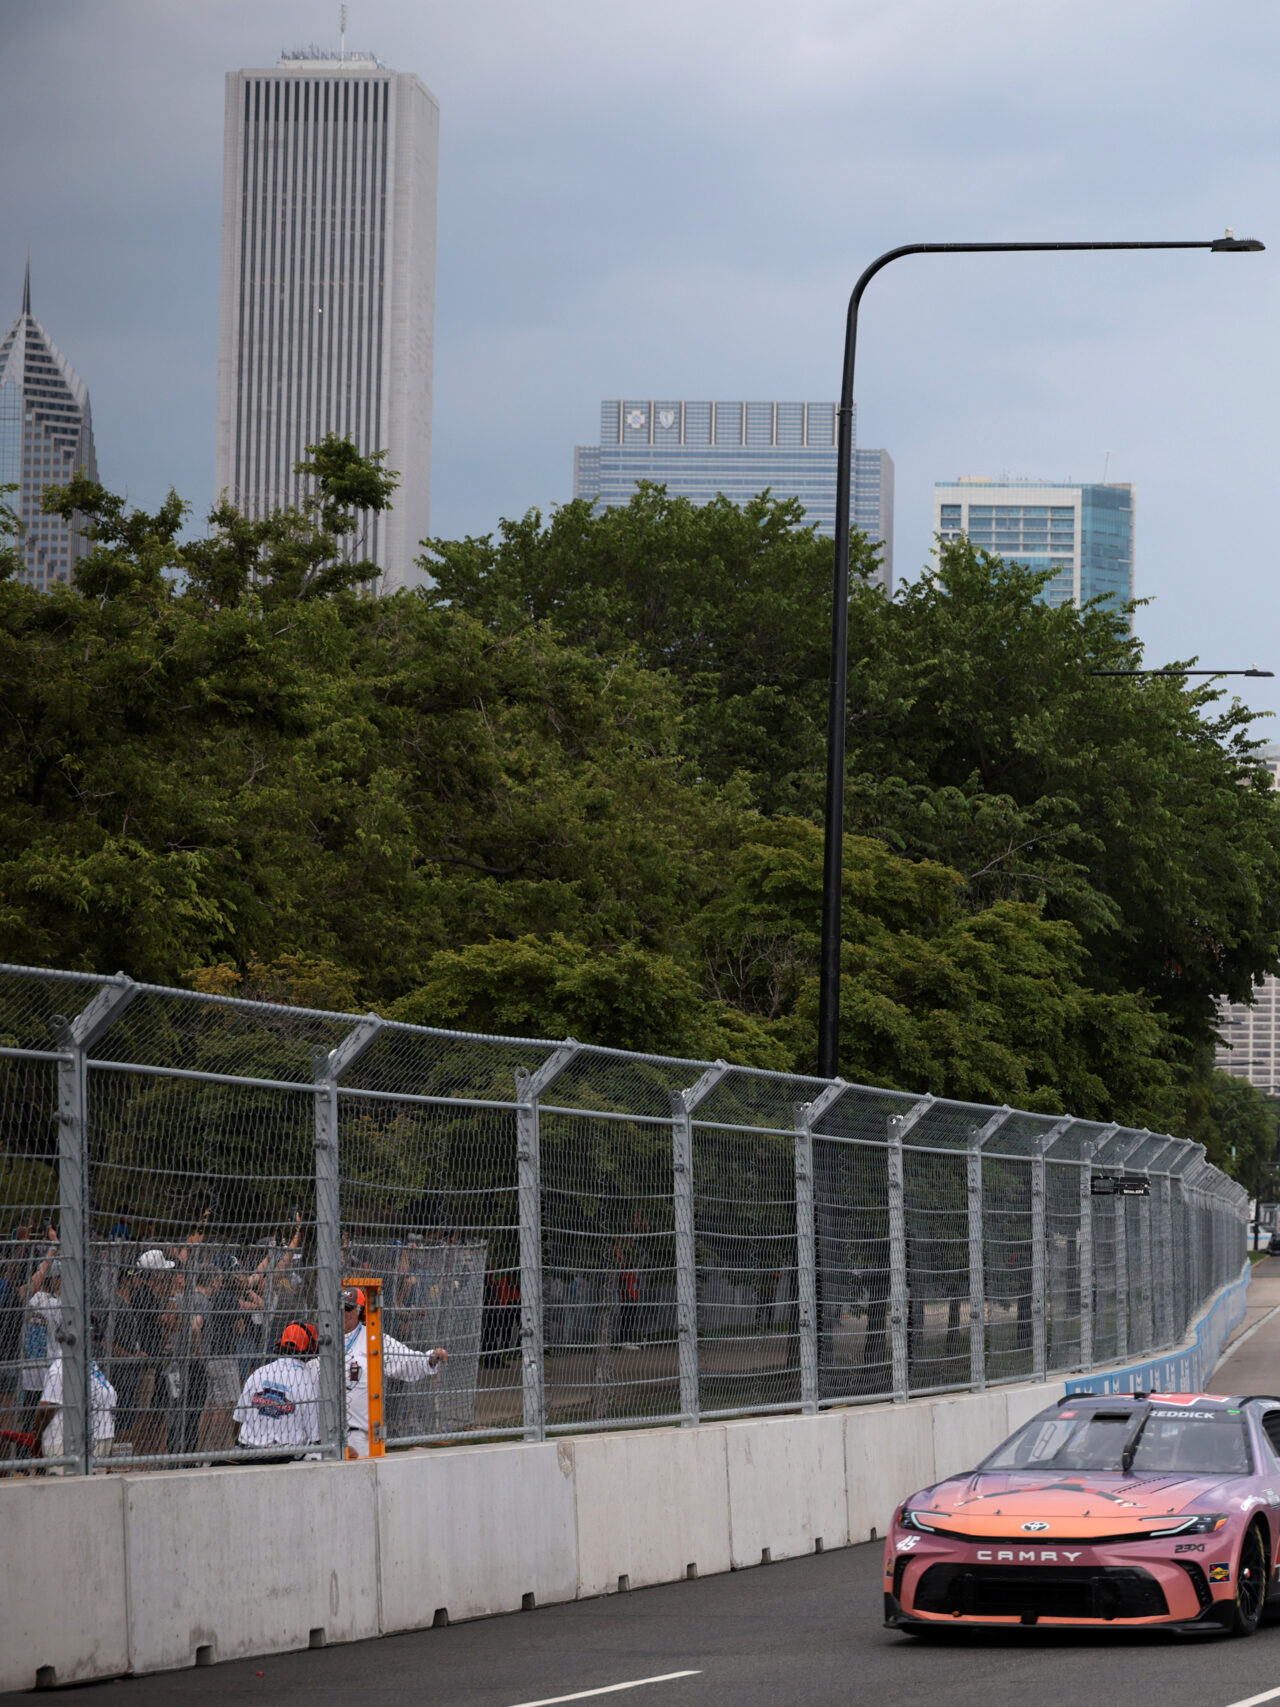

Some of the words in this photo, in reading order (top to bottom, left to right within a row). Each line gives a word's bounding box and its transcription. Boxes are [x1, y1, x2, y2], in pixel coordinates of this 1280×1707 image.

[1149, 1410, 1215, 1419] REDDICK
[896, 1535, 921, 1551] 45
[976, 1550, 1083, 1562] CAMRY
